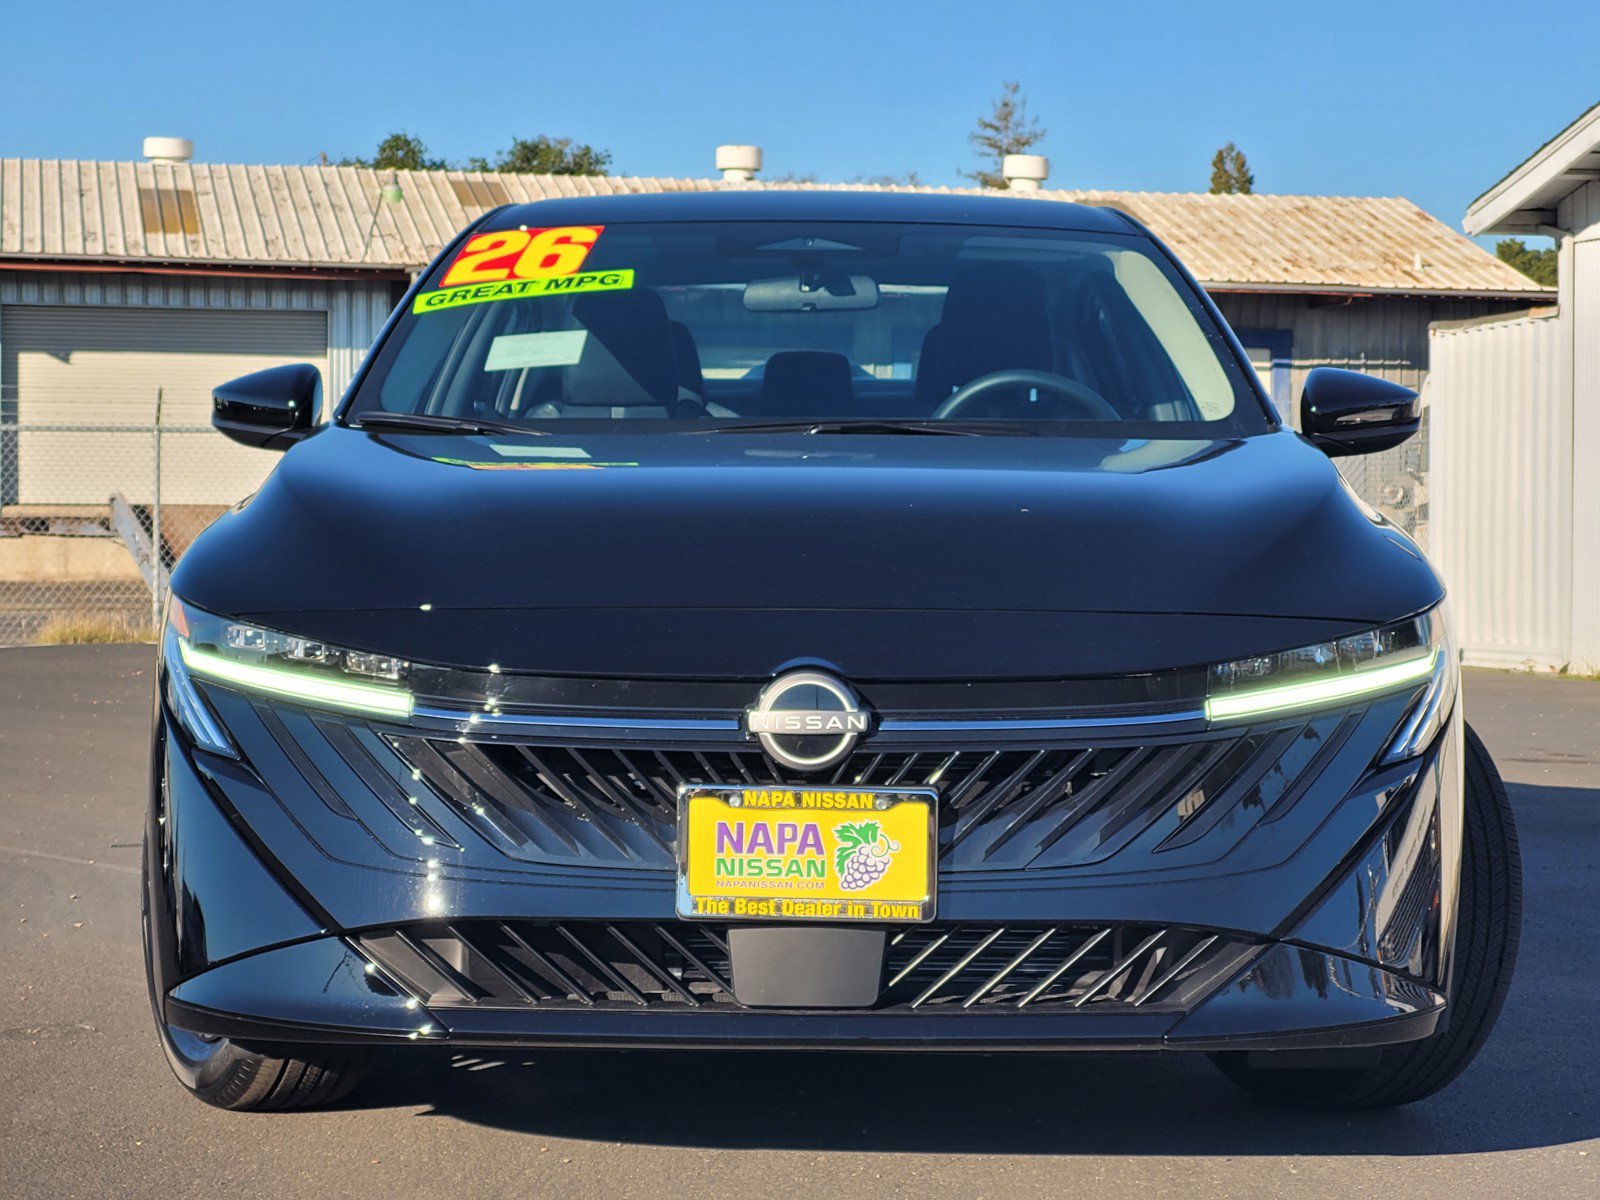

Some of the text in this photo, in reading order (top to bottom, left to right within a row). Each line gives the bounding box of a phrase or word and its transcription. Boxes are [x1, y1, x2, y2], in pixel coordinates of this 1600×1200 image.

[443, 226, 598, 285] 26
[425, 273, 623, 307] GREAT MPG
[753, 715, 865, 730] NISSAN
[743, 790, 875, 809] NAPA NISSAN
[716, 822, 825, 855] NAPA
[716, 858, 826, 877] NISSAN
[716, 880, 825, 889] NAPANISSAN.COM
[695, 897, 919, 919] The Best Dealer in Town
